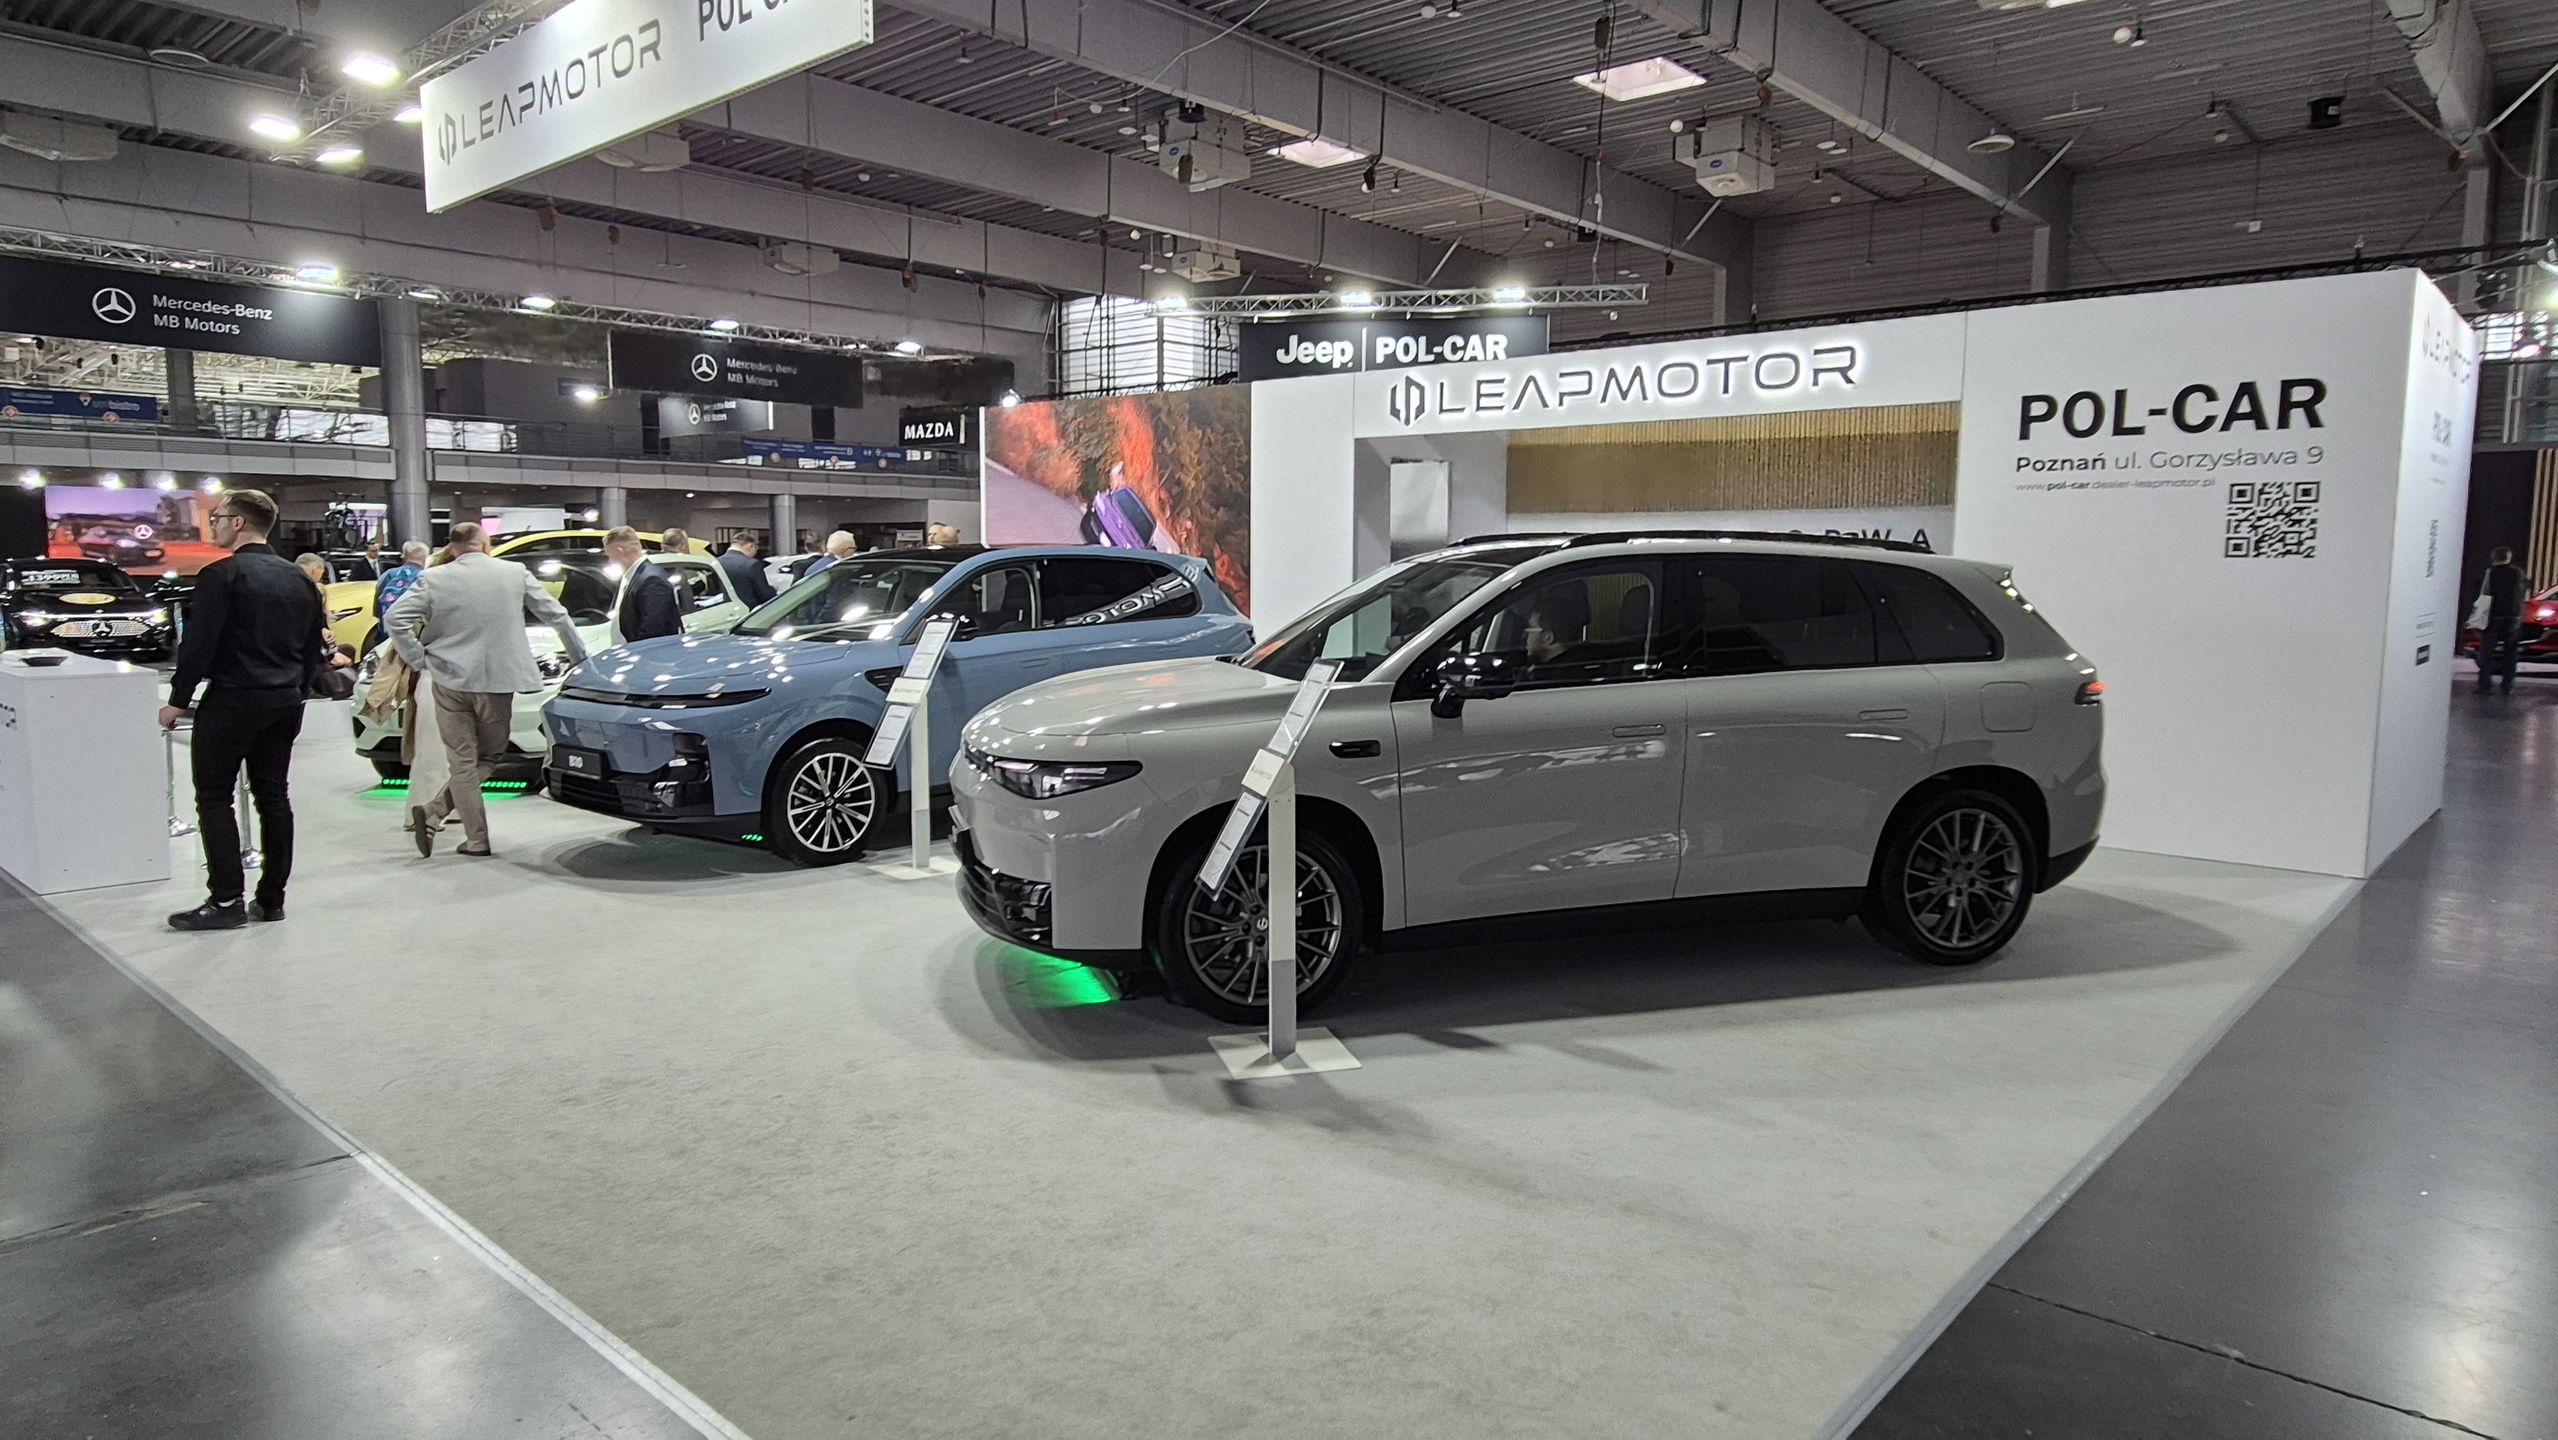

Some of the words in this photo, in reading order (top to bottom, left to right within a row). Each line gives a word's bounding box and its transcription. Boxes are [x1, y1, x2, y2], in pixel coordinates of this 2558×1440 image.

[462, 18, 661, 148] LEAPMOTOR
[152, 294, 273, 320] Mercedes-Benz
[153, 313, 180, 328] MB
[184, 317, 241, 335] Motors
[1276, 334, 1354, 368] Jeep
[1376, 334, 1508, 364] POL-CAR
[1438, 345, 1857, 415] LEAPMOTOR
[2018, 378, 2328, 441] POL-CAR
[904, 421, 954, 440] MAZDA
[2016, 453, 2106, 473] Poznań
[2115, 452, 2142, 470] ul.
[2150, 448, 2298, 472] Gorzysława
[2307, 446, 2324, 464] 9
